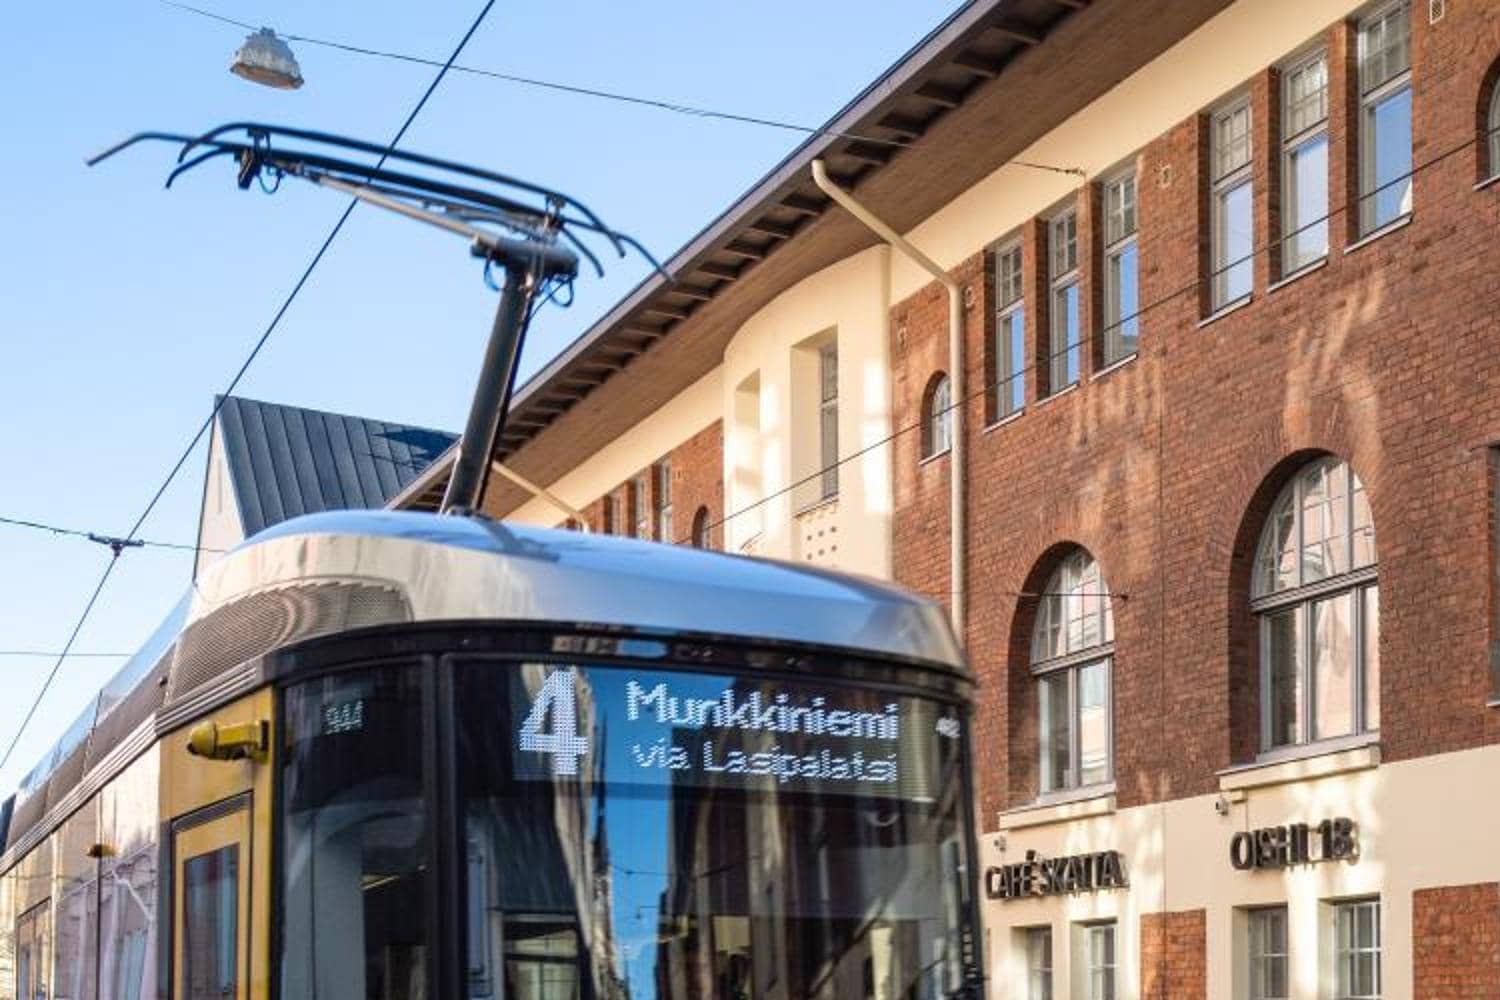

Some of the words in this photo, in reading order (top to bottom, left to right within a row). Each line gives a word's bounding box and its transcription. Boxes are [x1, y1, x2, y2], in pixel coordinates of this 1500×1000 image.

[519, 668, 589, 775] 4
[625, 679, 899, 740] Munkkiniemi
[632, 738, 691, 769] via
[702, 740, 898, 783] Lasipalatsi
[985, 849, 1043, 901] CAFÉ
